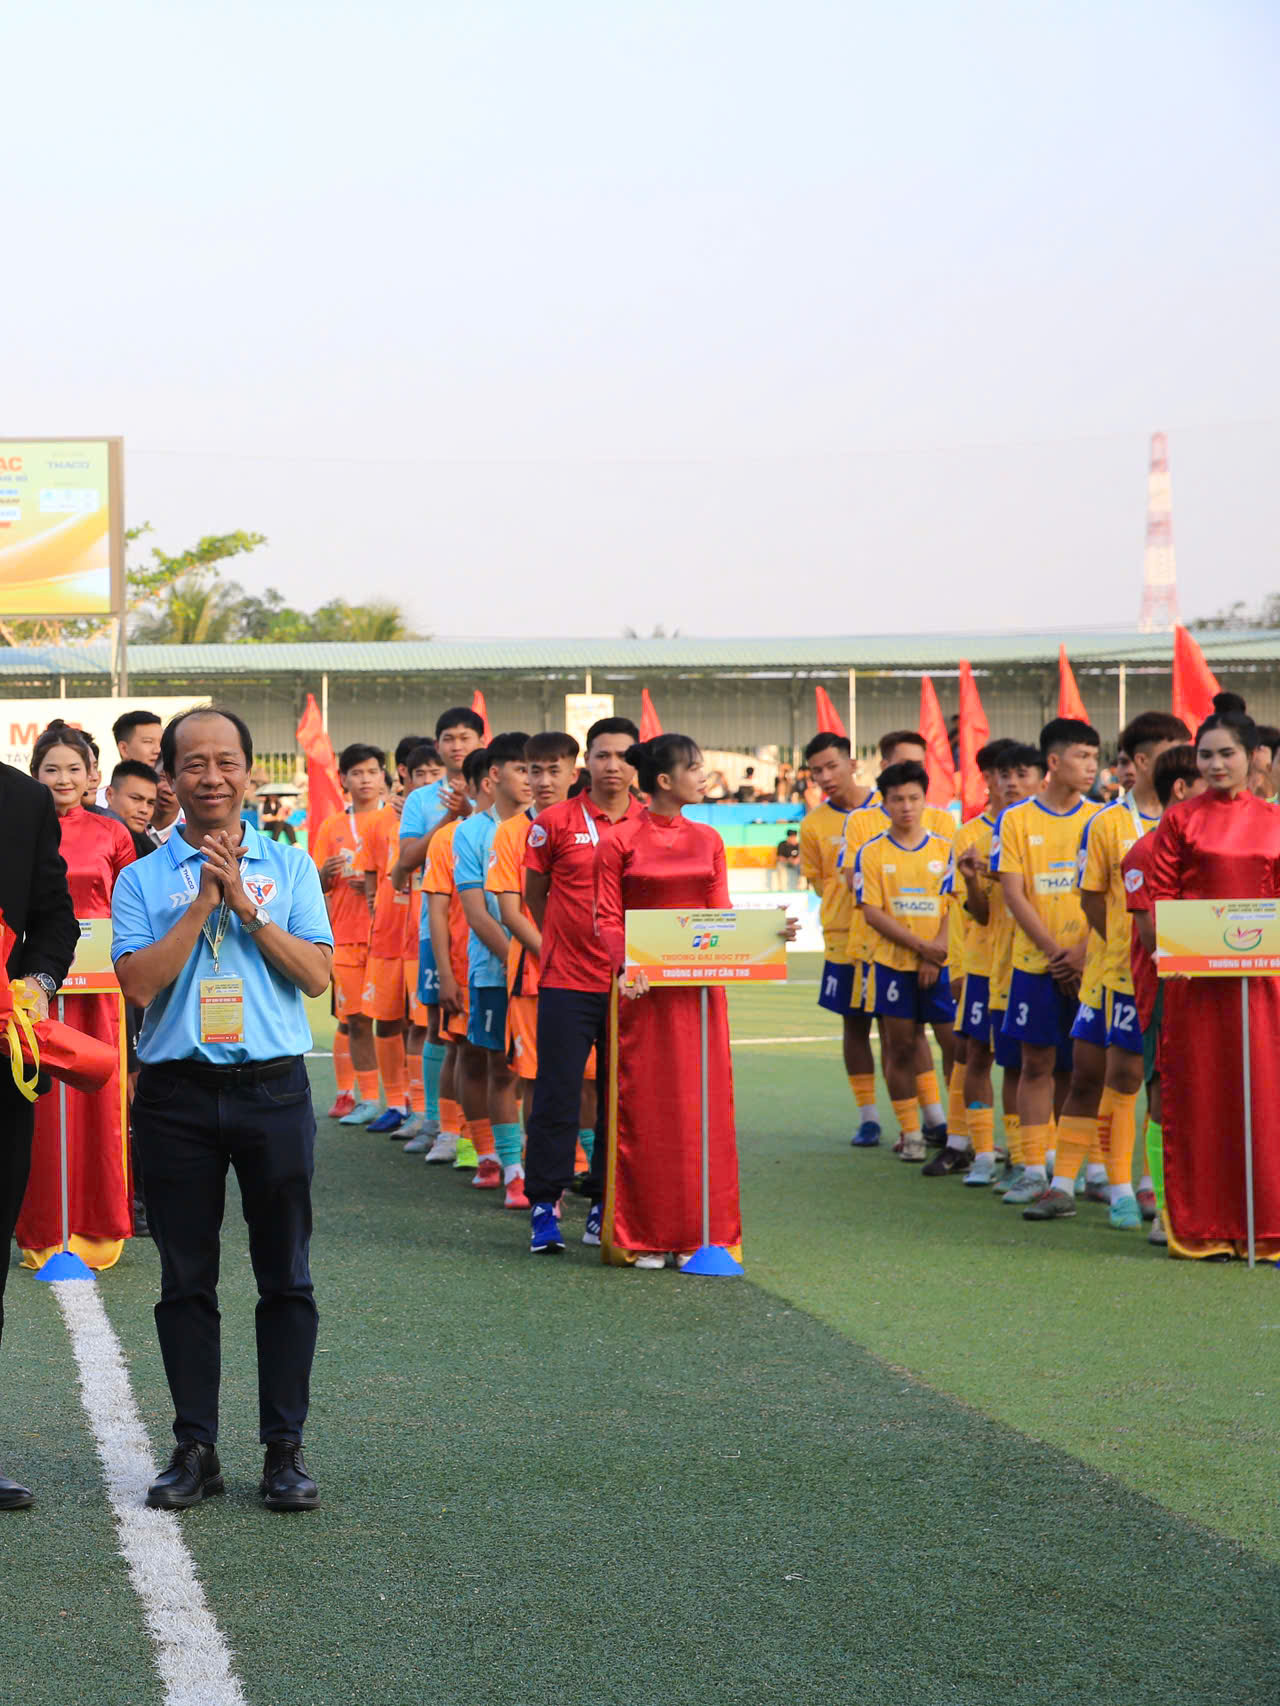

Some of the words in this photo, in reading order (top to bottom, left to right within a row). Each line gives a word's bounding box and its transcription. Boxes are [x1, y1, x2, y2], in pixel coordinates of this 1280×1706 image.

[183, 869, 195, 890] THACO
[892, 901, 934, 912] THACO
[693, 933, 719, 951] FPT
[886, 980, 899, 1002] 6
[485, 1009, 493, 1032] 1
[970, 1001, 983, 1025] 5
[1015, 1002, 1029, 1027] 3
[1113, 1002, 1136, 1032] 12
